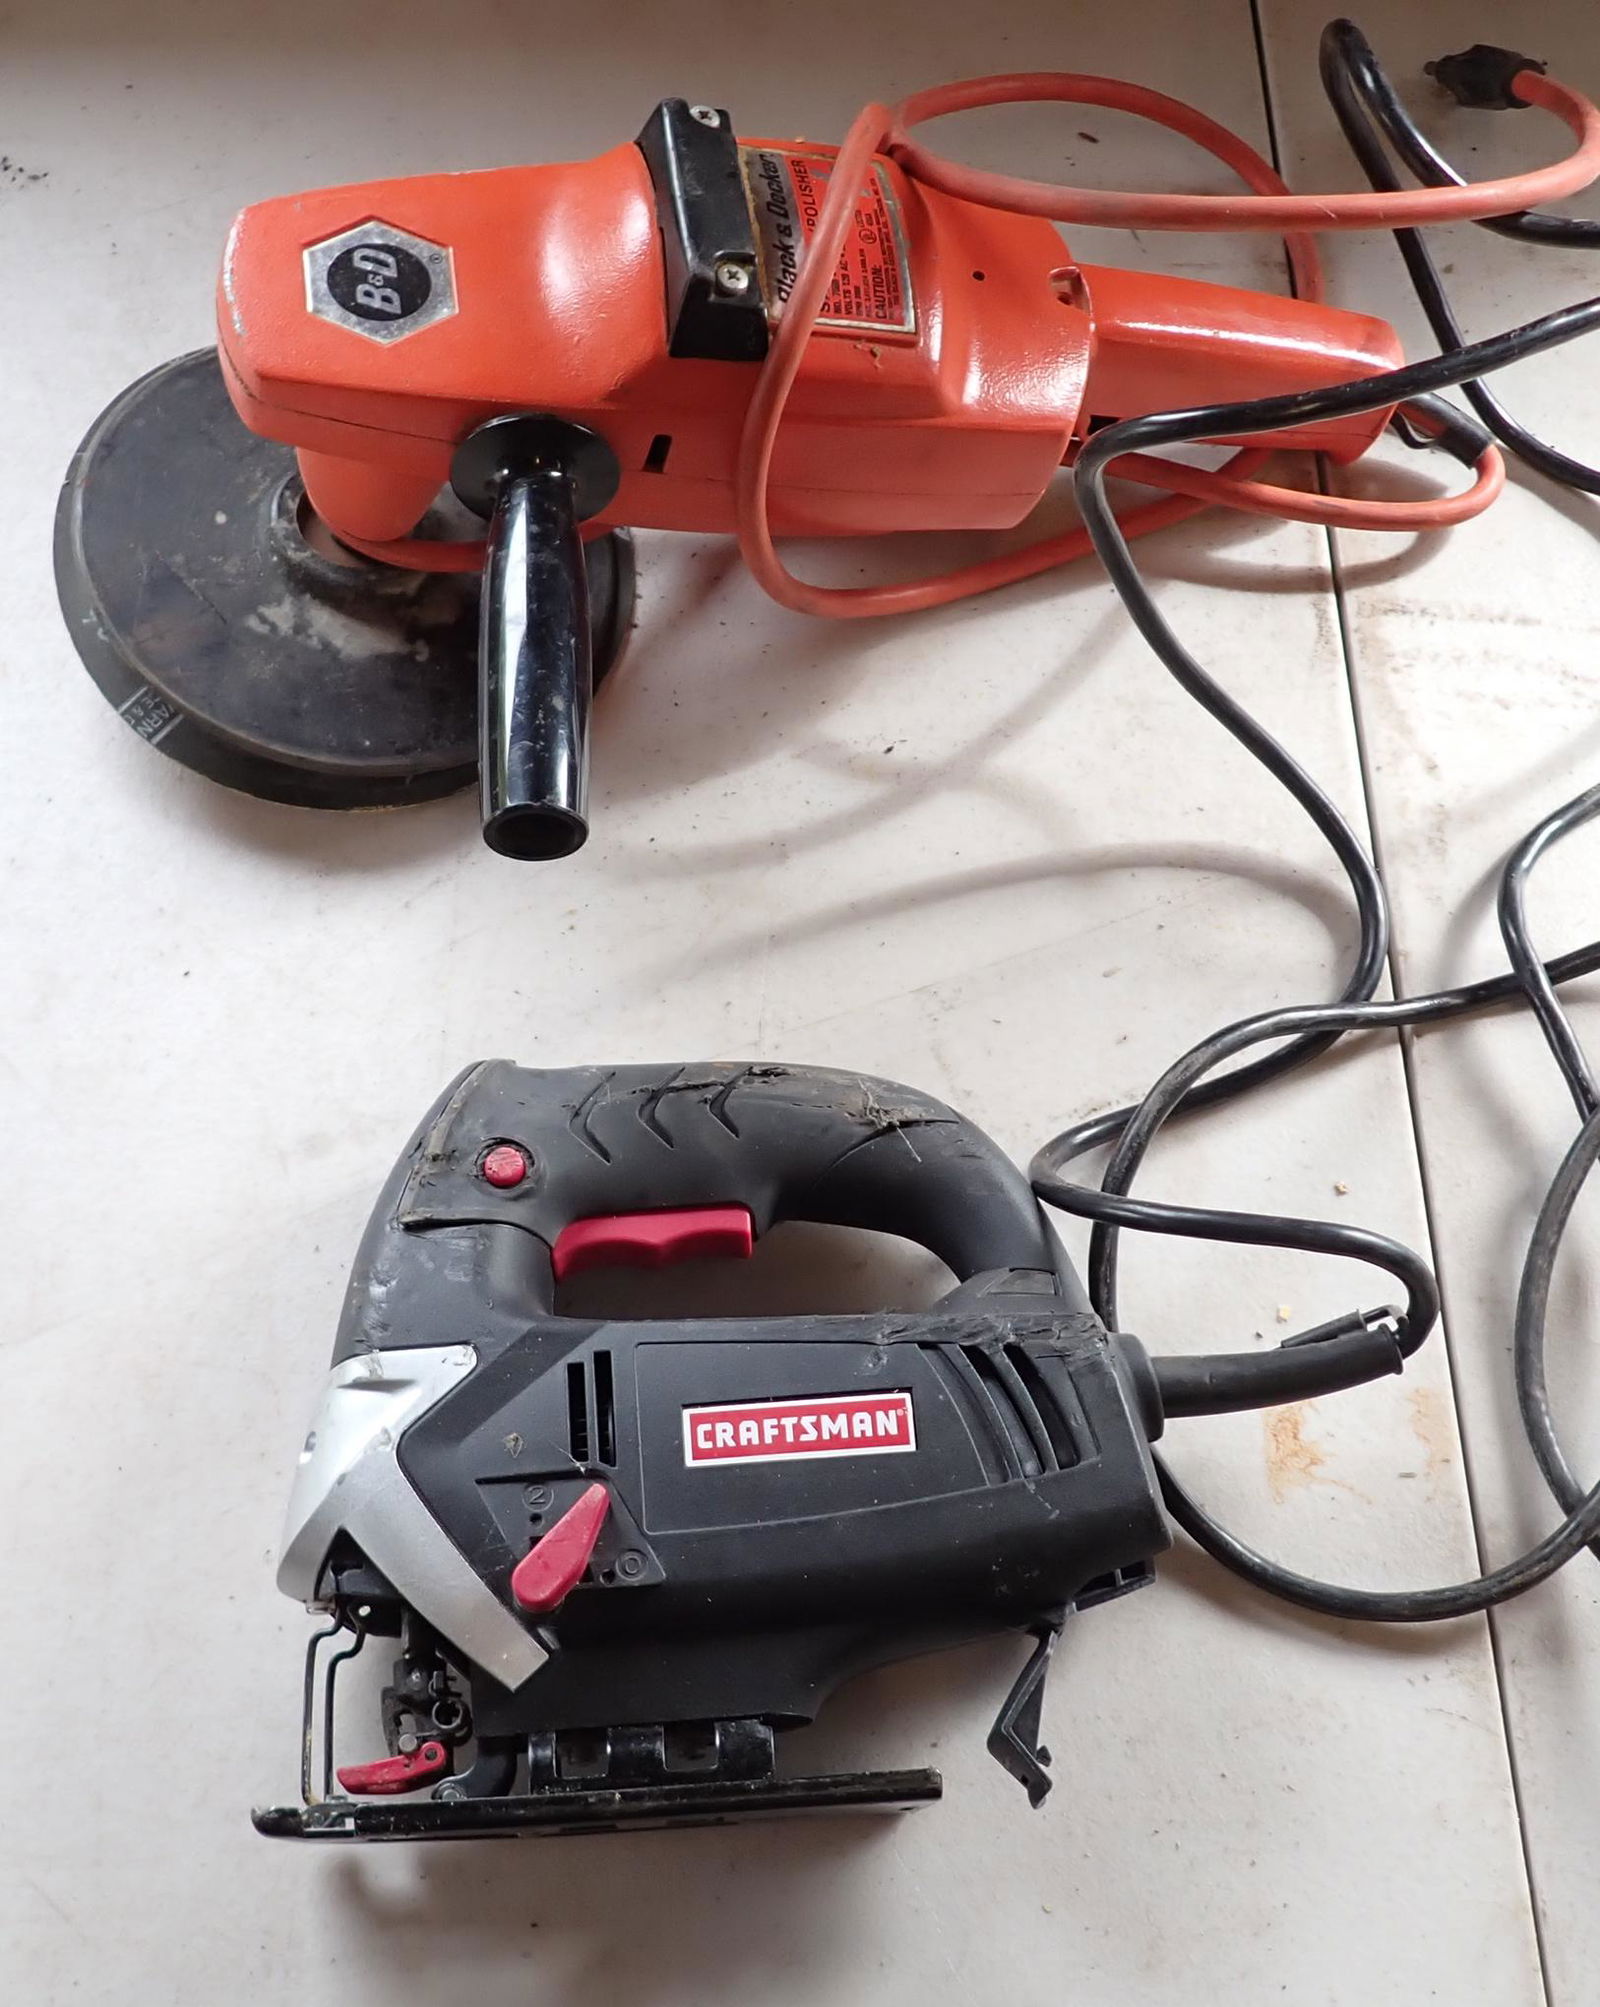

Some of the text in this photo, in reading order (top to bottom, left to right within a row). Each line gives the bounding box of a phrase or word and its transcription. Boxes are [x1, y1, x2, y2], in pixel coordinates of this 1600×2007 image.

[759, 154, 790, 219] Decker
[776, 223, 792, 238] &
[871, 265, 888, 319] CAUTION:
[696, 1409, 898, 1449] CRAFTSMAN
